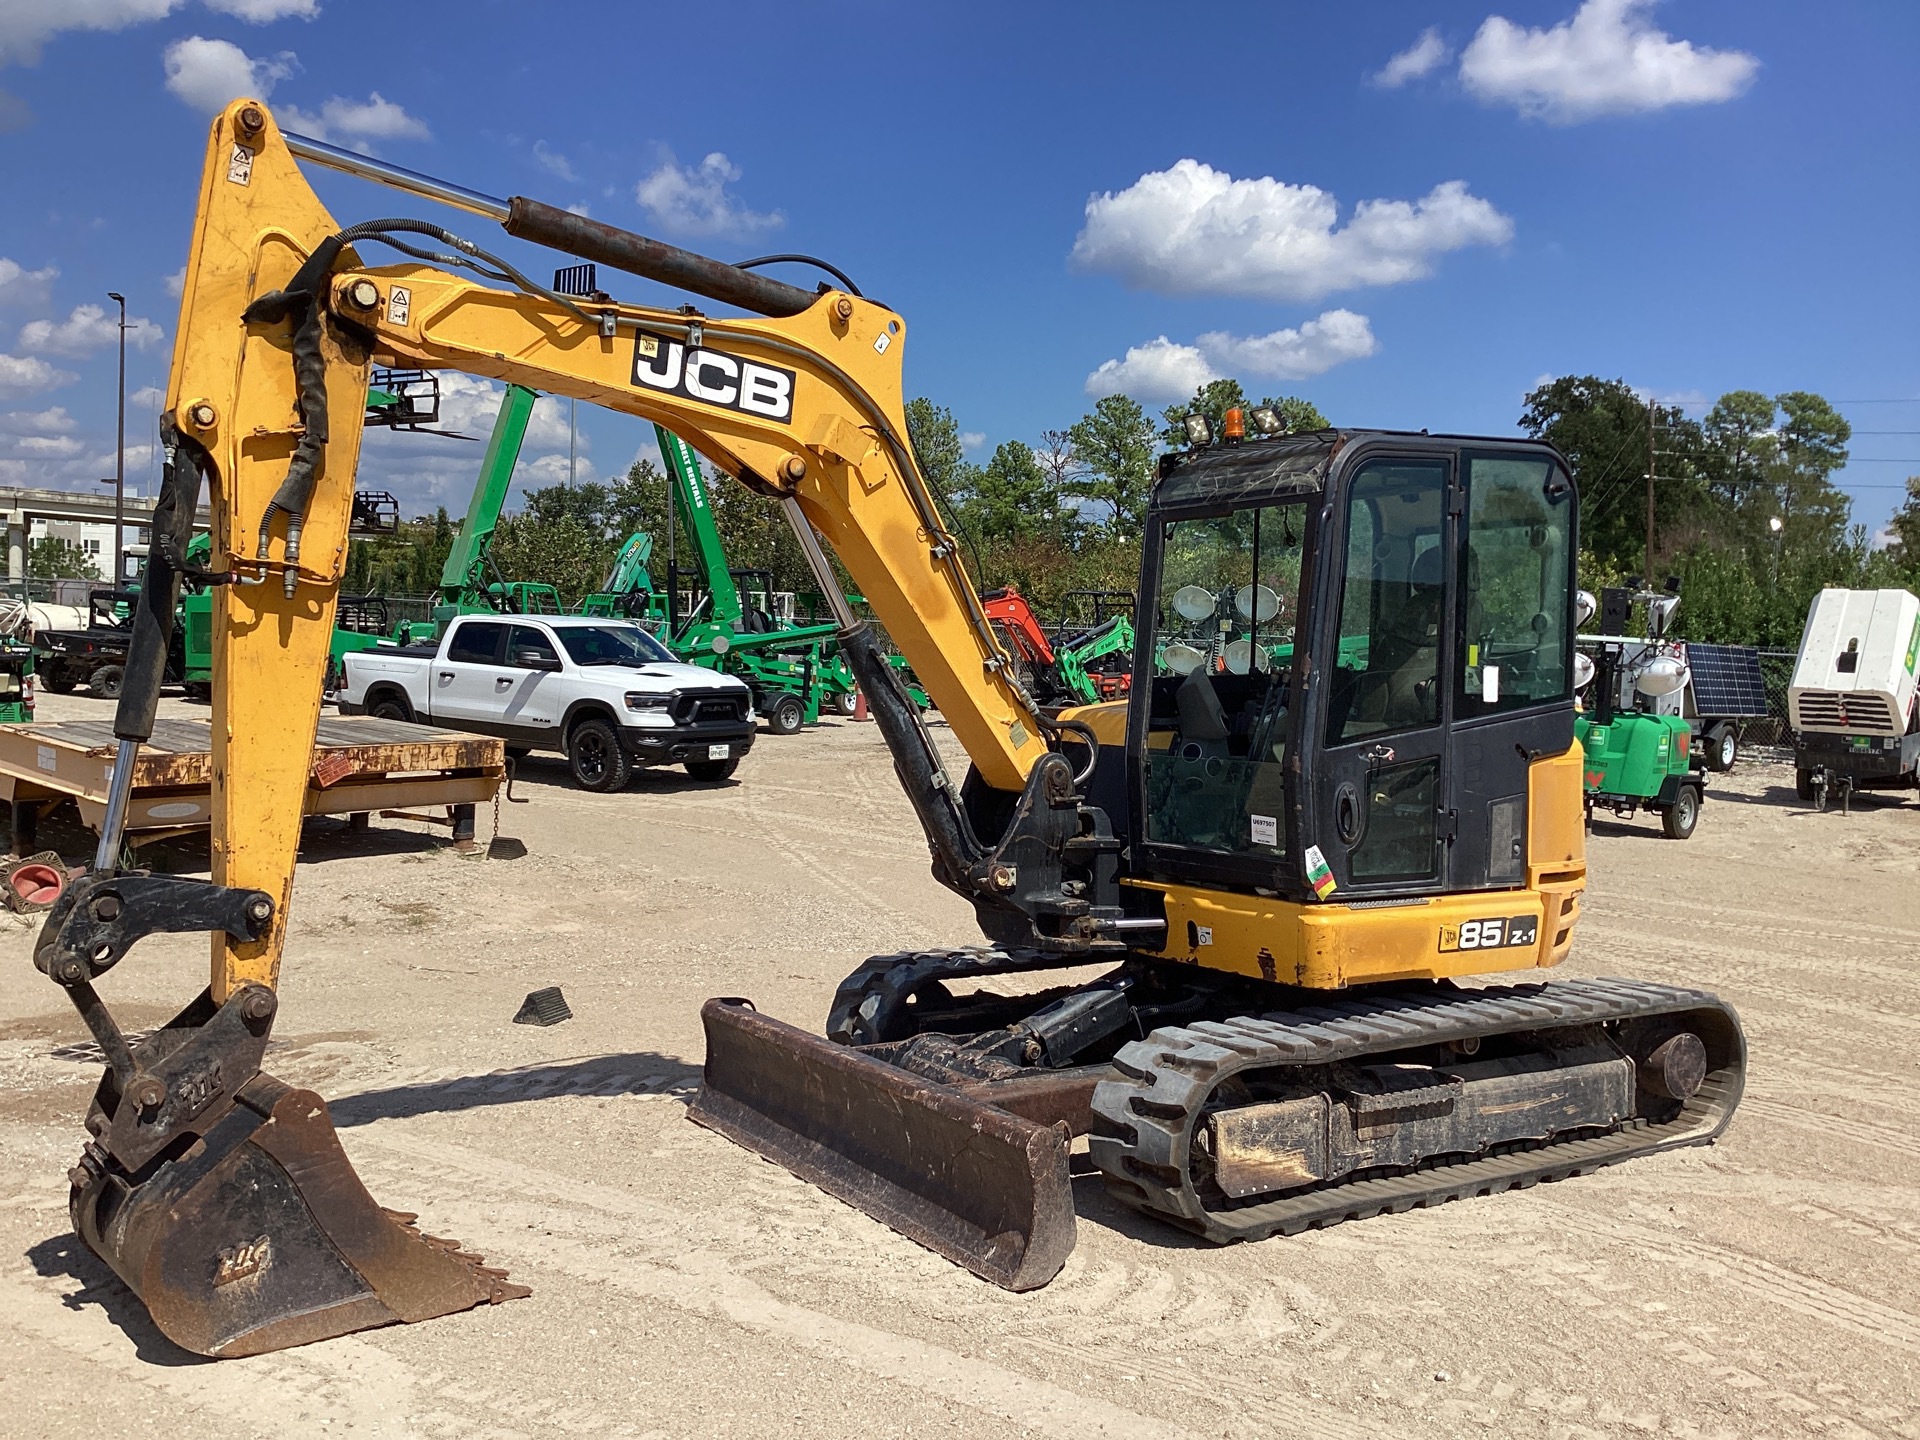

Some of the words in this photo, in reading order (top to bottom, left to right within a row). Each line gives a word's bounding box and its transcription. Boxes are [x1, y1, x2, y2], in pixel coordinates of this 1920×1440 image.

[636, 341, 791, 418] JCB
[685, 465, 704, 509] RENTALS
[702, 705, 732, 713] RAM
[1459, 920, 1503, 949] 85
[1510, 928, 1536, 945] Z-1
